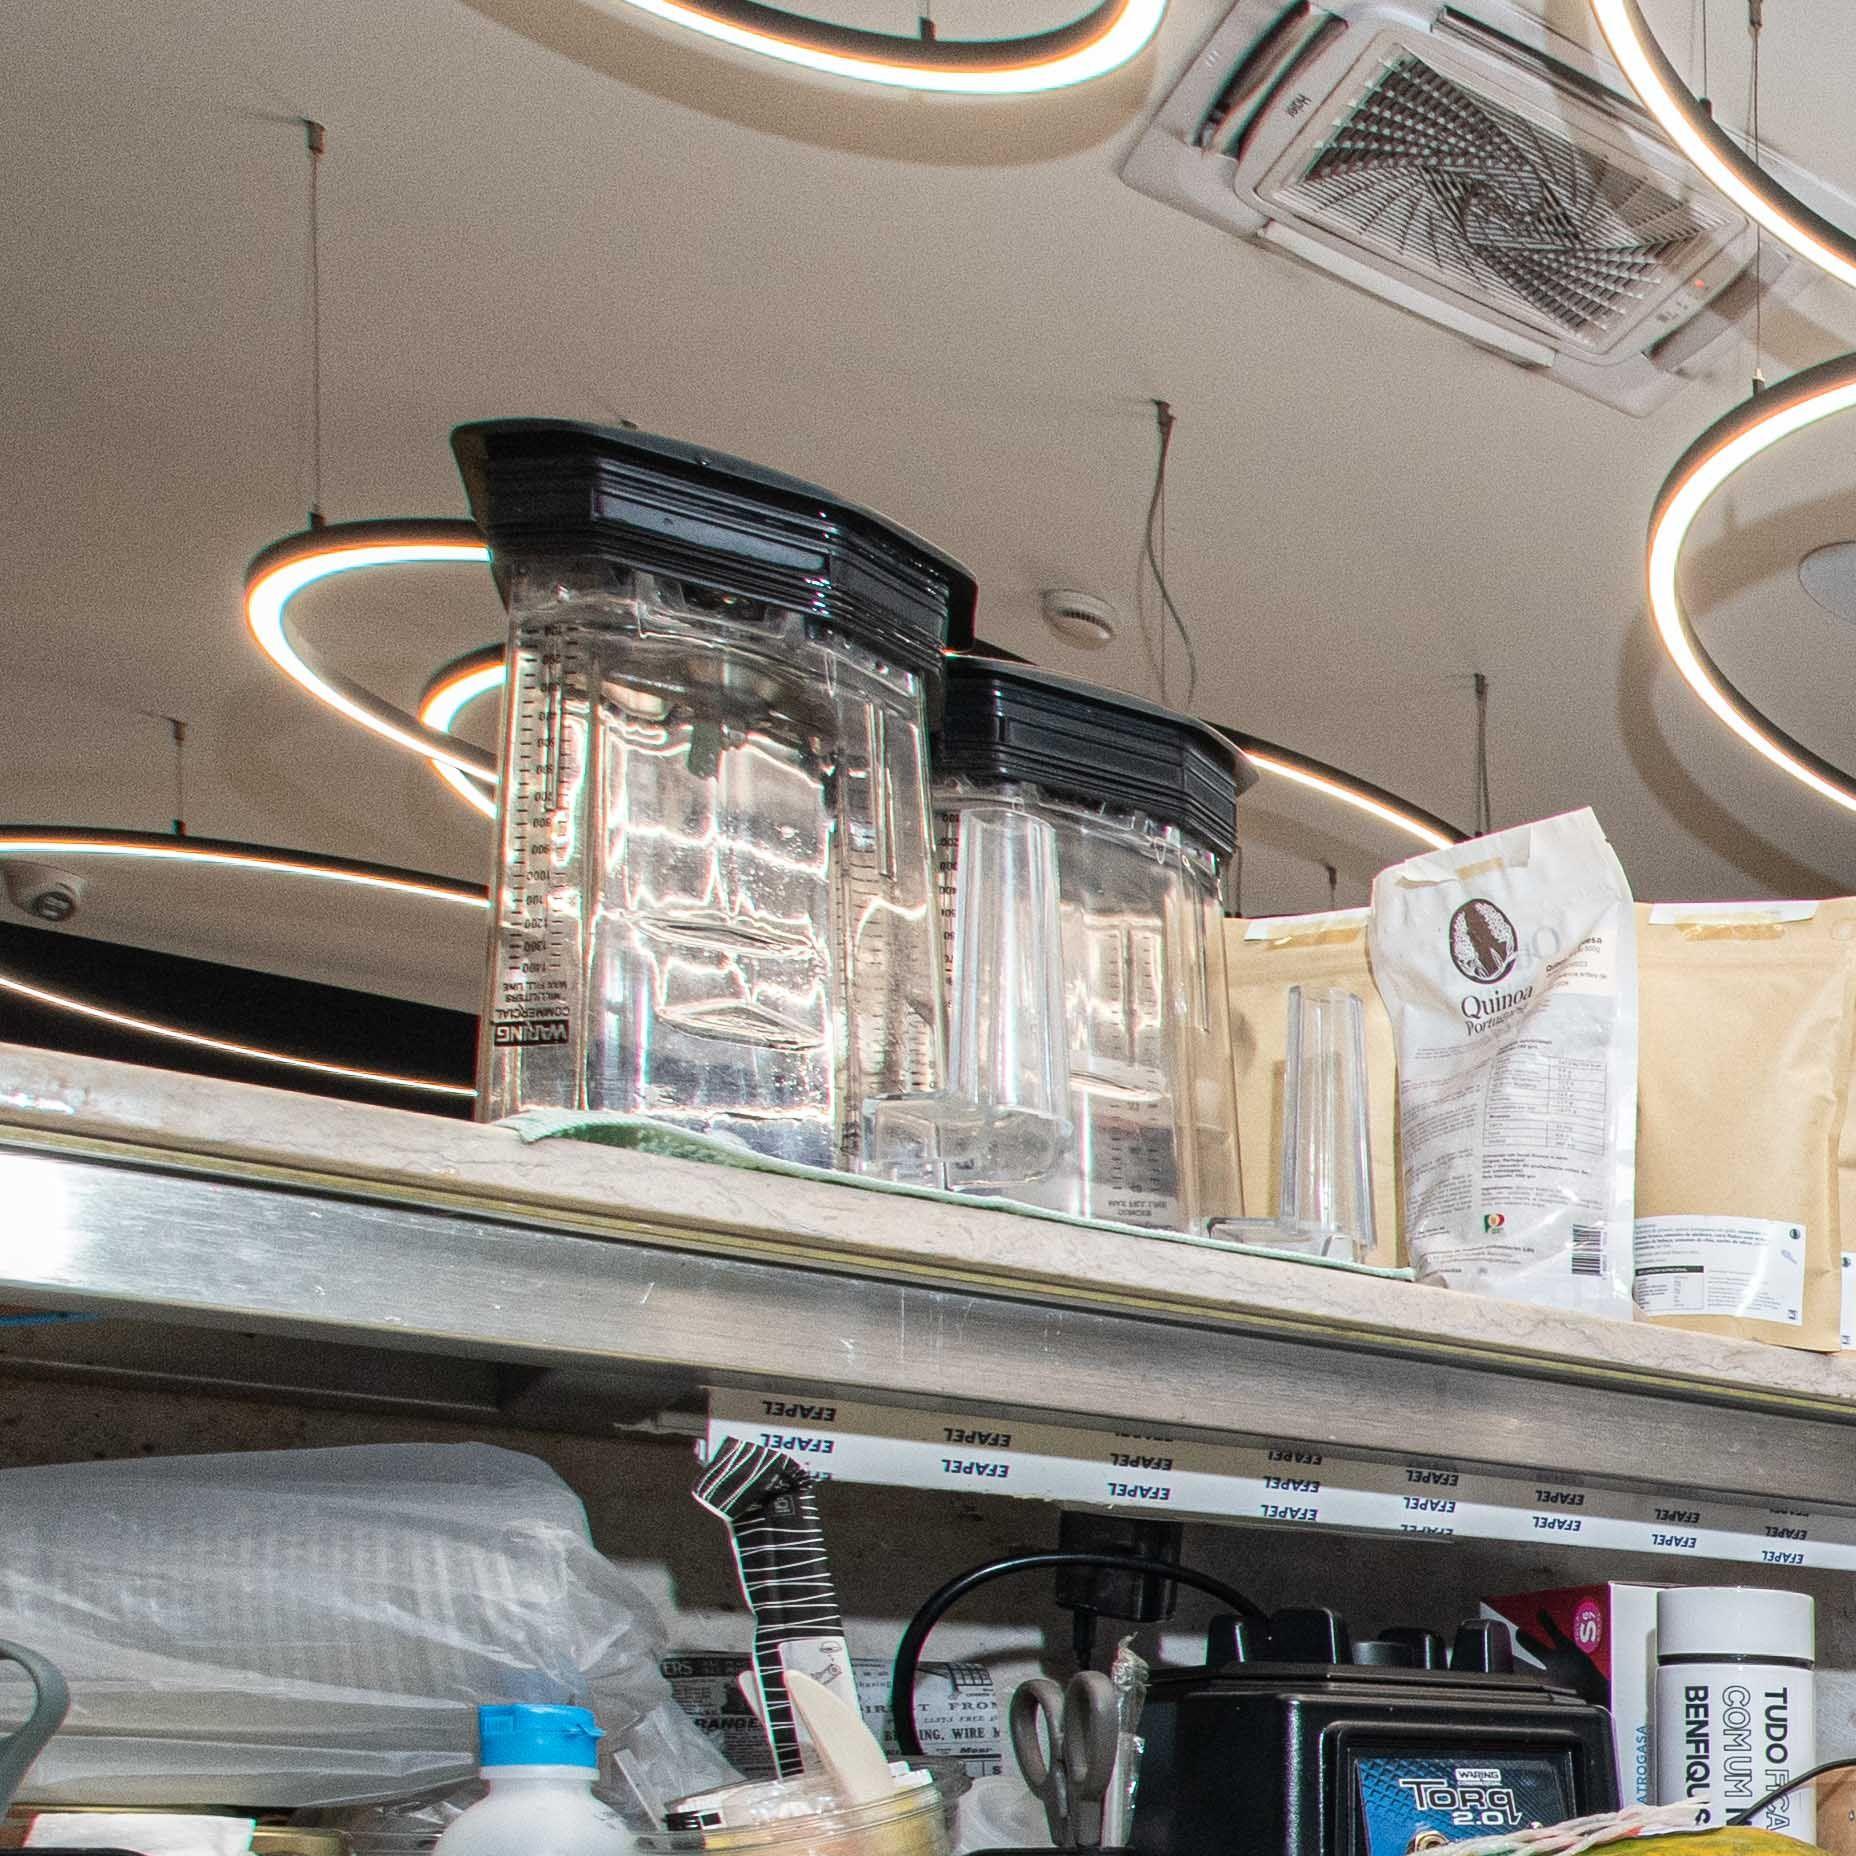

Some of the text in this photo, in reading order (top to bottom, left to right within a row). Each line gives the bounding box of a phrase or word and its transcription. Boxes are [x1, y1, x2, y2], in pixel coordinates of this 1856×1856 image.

[1461, 985, 1533, 1020] Quinoa
[495, 1022, 569, 1045] WARING
[762, 1401, 836, 1422] EFAPEL
[943, 1428, 1011, 1448] EFAPEL
[940, 1459, 1009, 1478] EFAPEL
[1110, 1452, 1173, 1471] EFAPEL
[1262, 1476, 1321, 1494] EFAPEL
[1404, 1469, 1459, 1487] EFAPEL
[1107, 1482, 1170, 1500] EFAPEL
[1535, 1490, 1584, 1506] EFAPEL
[1260, 1504, 1318, 1521] EFAPEL
[1403, 1496, 1457, 1513] EFAPEL
[1532, 1516, 1582, 1532] EFAPEL
[1654, 1508, 1700, 1524] EFAPEL
[1650, 1533, 1696, 1549] EFAPEL
[1764, 1526, 1807, 1541] EFAPEL
[1761, 1550, 1804, 1565] EFAPEL
[1722, 1685, 1752, 1751] COM
[1765, 1687, 1788, 1764] TUDO
[952, 1727, 985, 1739] WIRE
[1457, 1770, 1500, 1780] WARING
[1723, 1756, 1753, 1797] UM
[1452, 1811, 1504, 1826] 2.0
